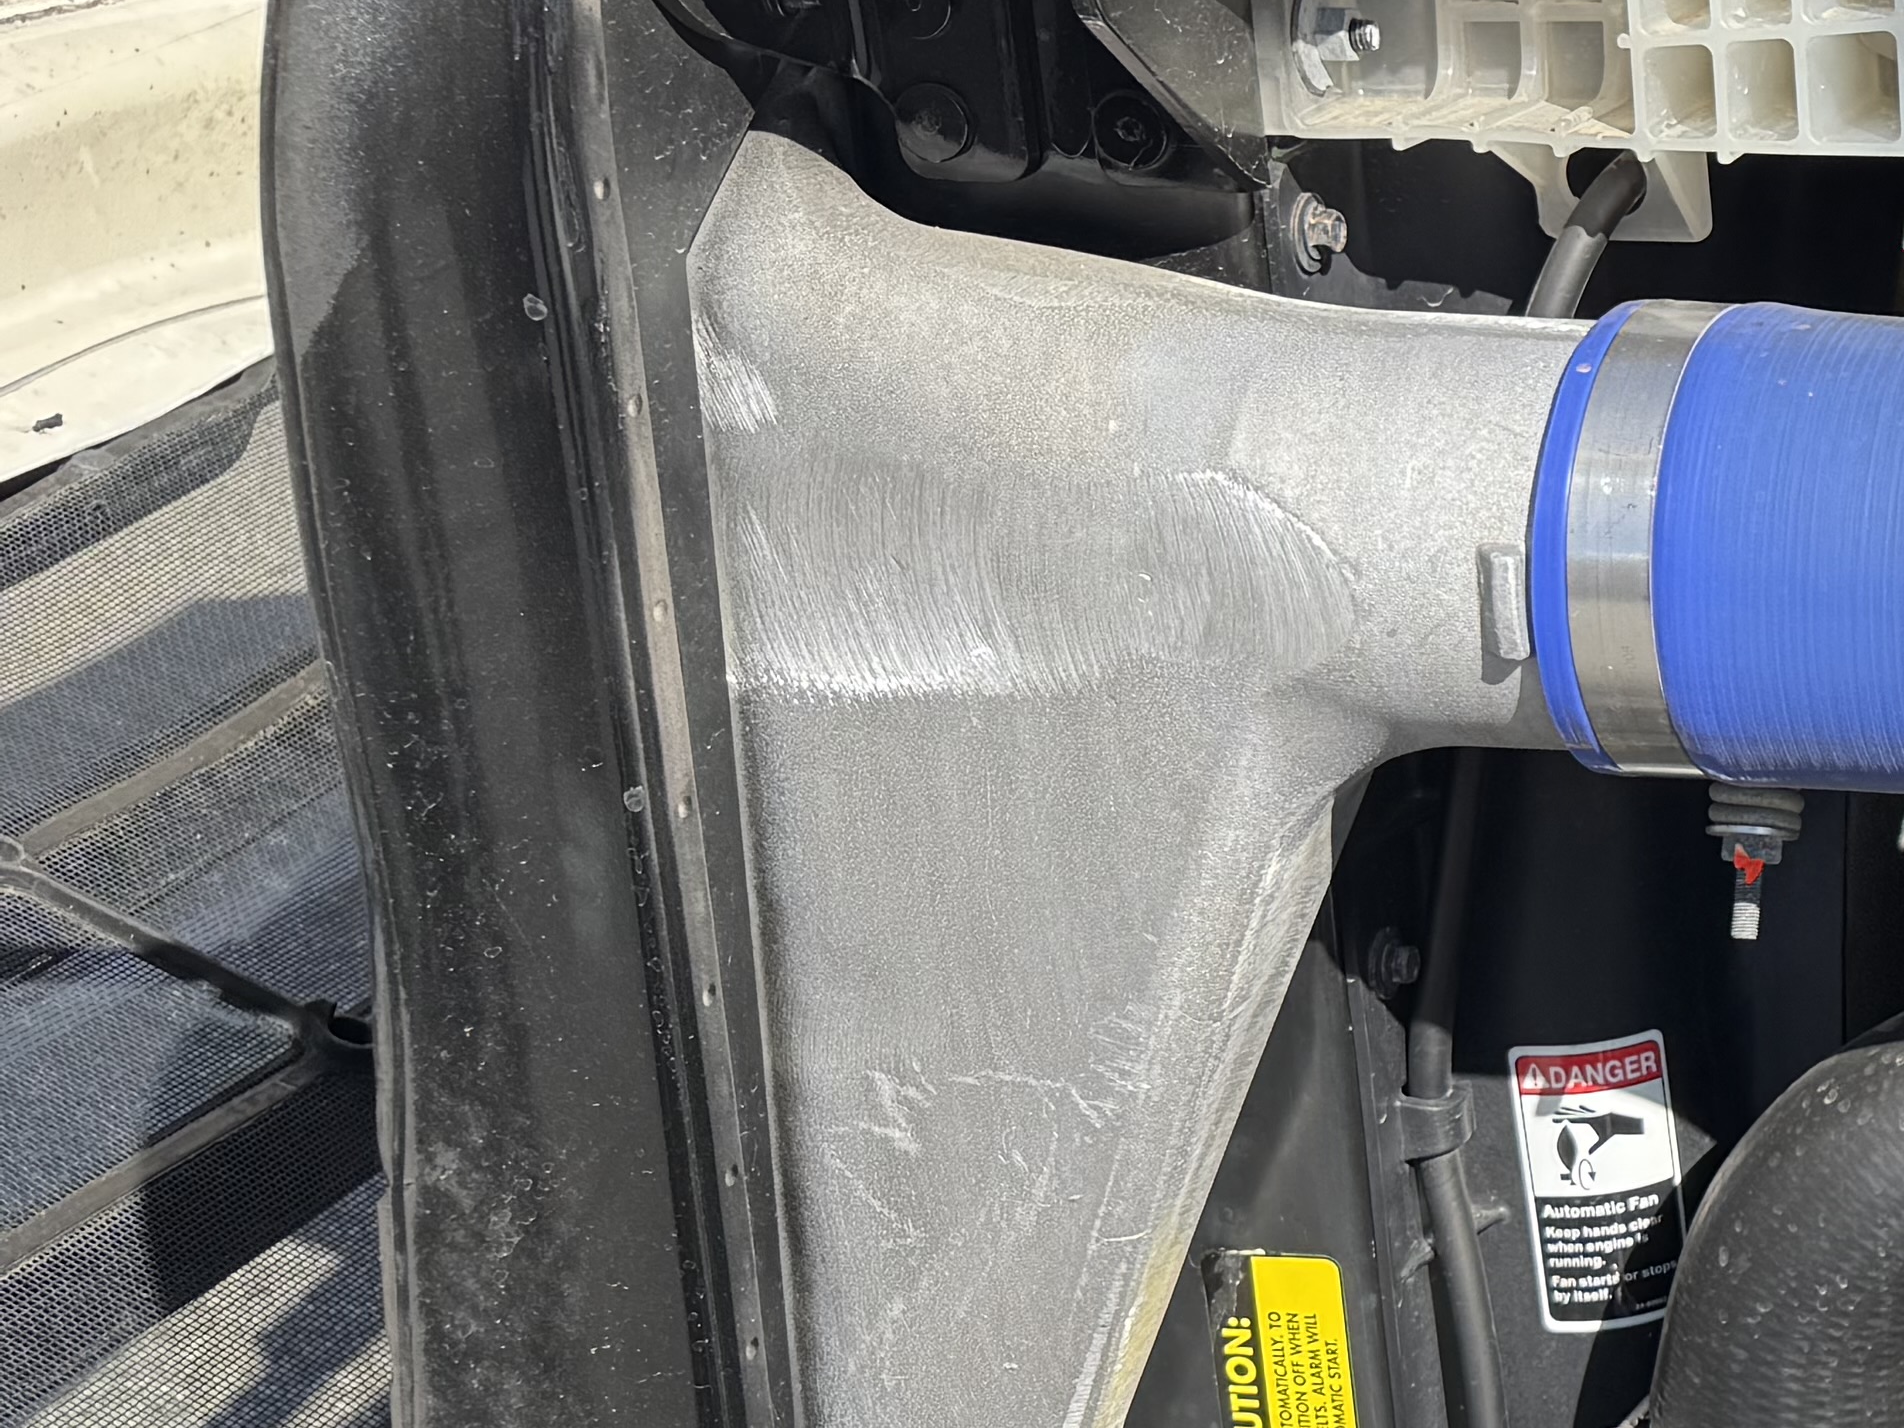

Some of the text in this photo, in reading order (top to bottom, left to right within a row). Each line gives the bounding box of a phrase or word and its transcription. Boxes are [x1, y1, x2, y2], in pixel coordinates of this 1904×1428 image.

[1549, 1051, 1657, 1090] DANGER
[1542, 1193, 1659, 1219] Automatic Fan
[1545, 1213, 1663, 1241] Keep hands clear
[1547, 1233, 1649, 1254] when engine is
[1549, 1255, 1606, 1270] running.
[1552, 1260, 1677, 1288] Fan starts or stops
[1553, 1286, 1612, 1304] by itself.
[1268, 1311, 1281, 1330] TO
[1286, 1312, 1304, 1357] WHEN
[1303, 1313, 1318, 1346] WILL
[1325, 1338, 1341, 1378] START.
[1293, 1360, 1307, 1387] OFF
[1311, 1350, 1325, 1396] ALARM
